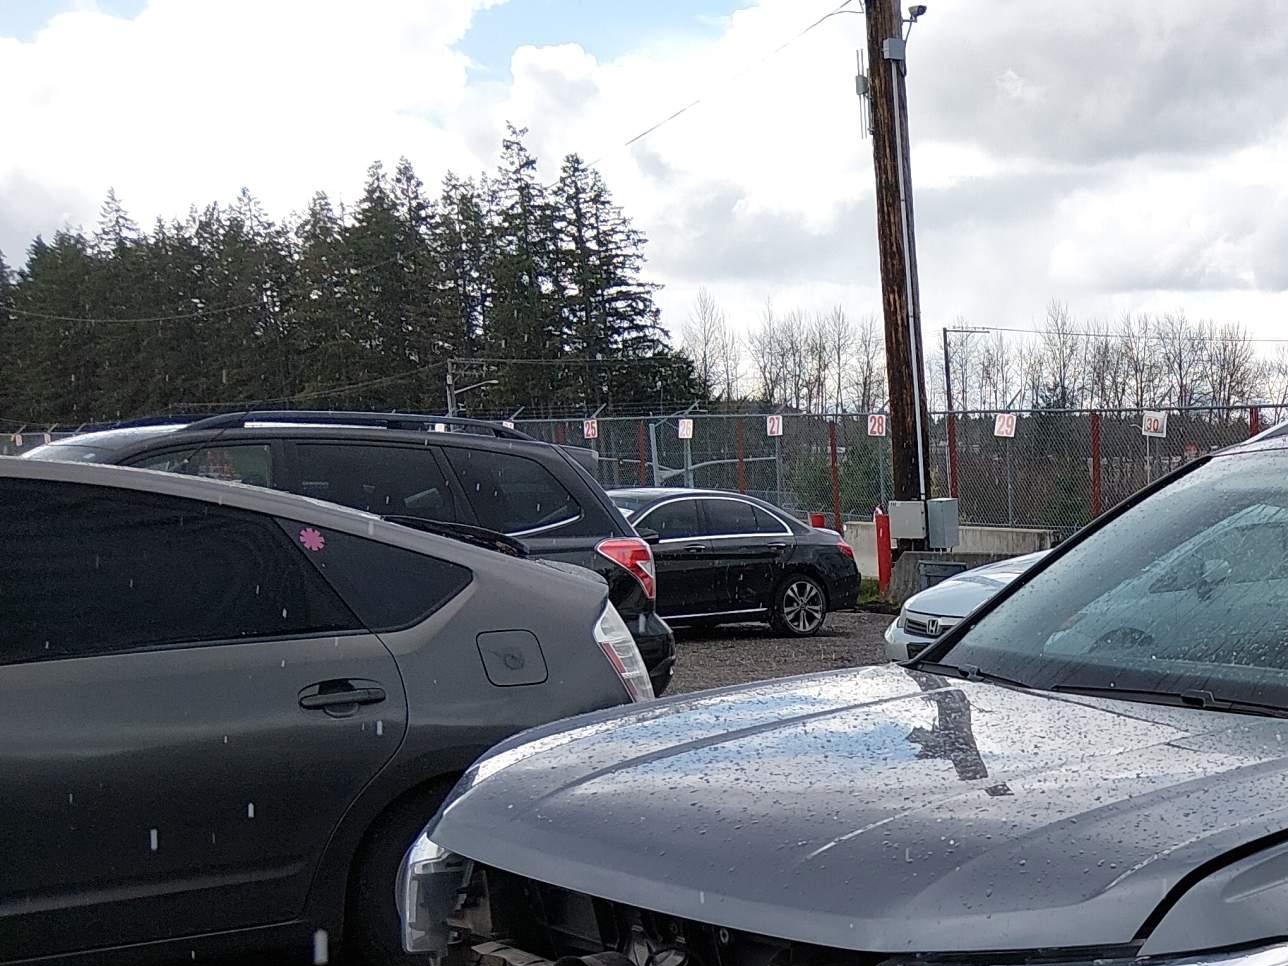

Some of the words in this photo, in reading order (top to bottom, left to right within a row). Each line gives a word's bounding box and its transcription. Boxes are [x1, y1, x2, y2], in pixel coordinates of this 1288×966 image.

[585, 421, 596, 437] 25
[680, 420, 692, 437] 26
[769, 417, 781, 435] 27
[870, 415, 884, 435] 28
[997, 415, 1014, 435] 29
[1146, 417, 1159, 431] 30
